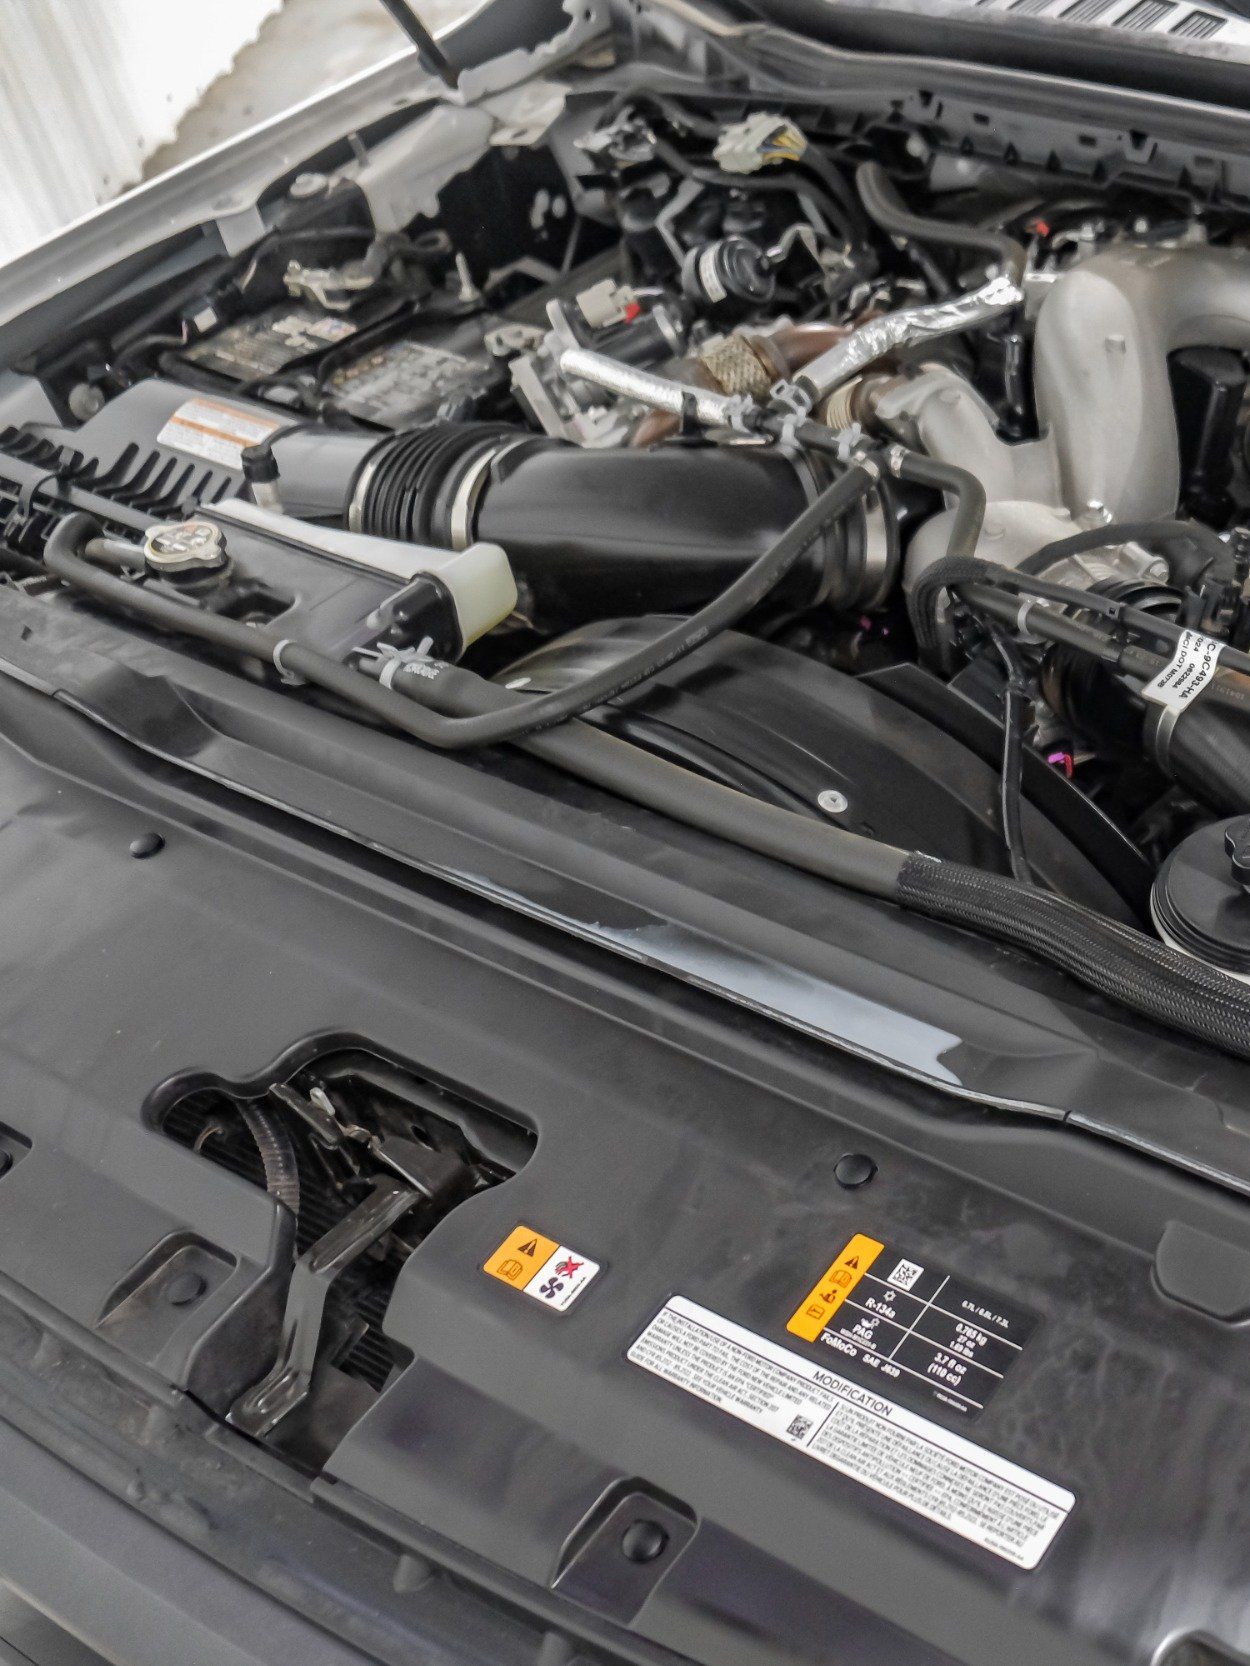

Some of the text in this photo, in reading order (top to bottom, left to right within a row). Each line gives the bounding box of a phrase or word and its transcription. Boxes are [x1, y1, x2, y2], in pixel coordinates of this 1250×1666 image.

[1176, 651, 1187, 669] DOT
[863, 1296, 898, 1319] R-134a
[850, 1323, 875, 1340] PAG
[818, 1331, 860, 1357] FoMoCo
[860, 1352, 882, 1368] SAE
[812, 1370, 894, 1418] MODIFICATION
